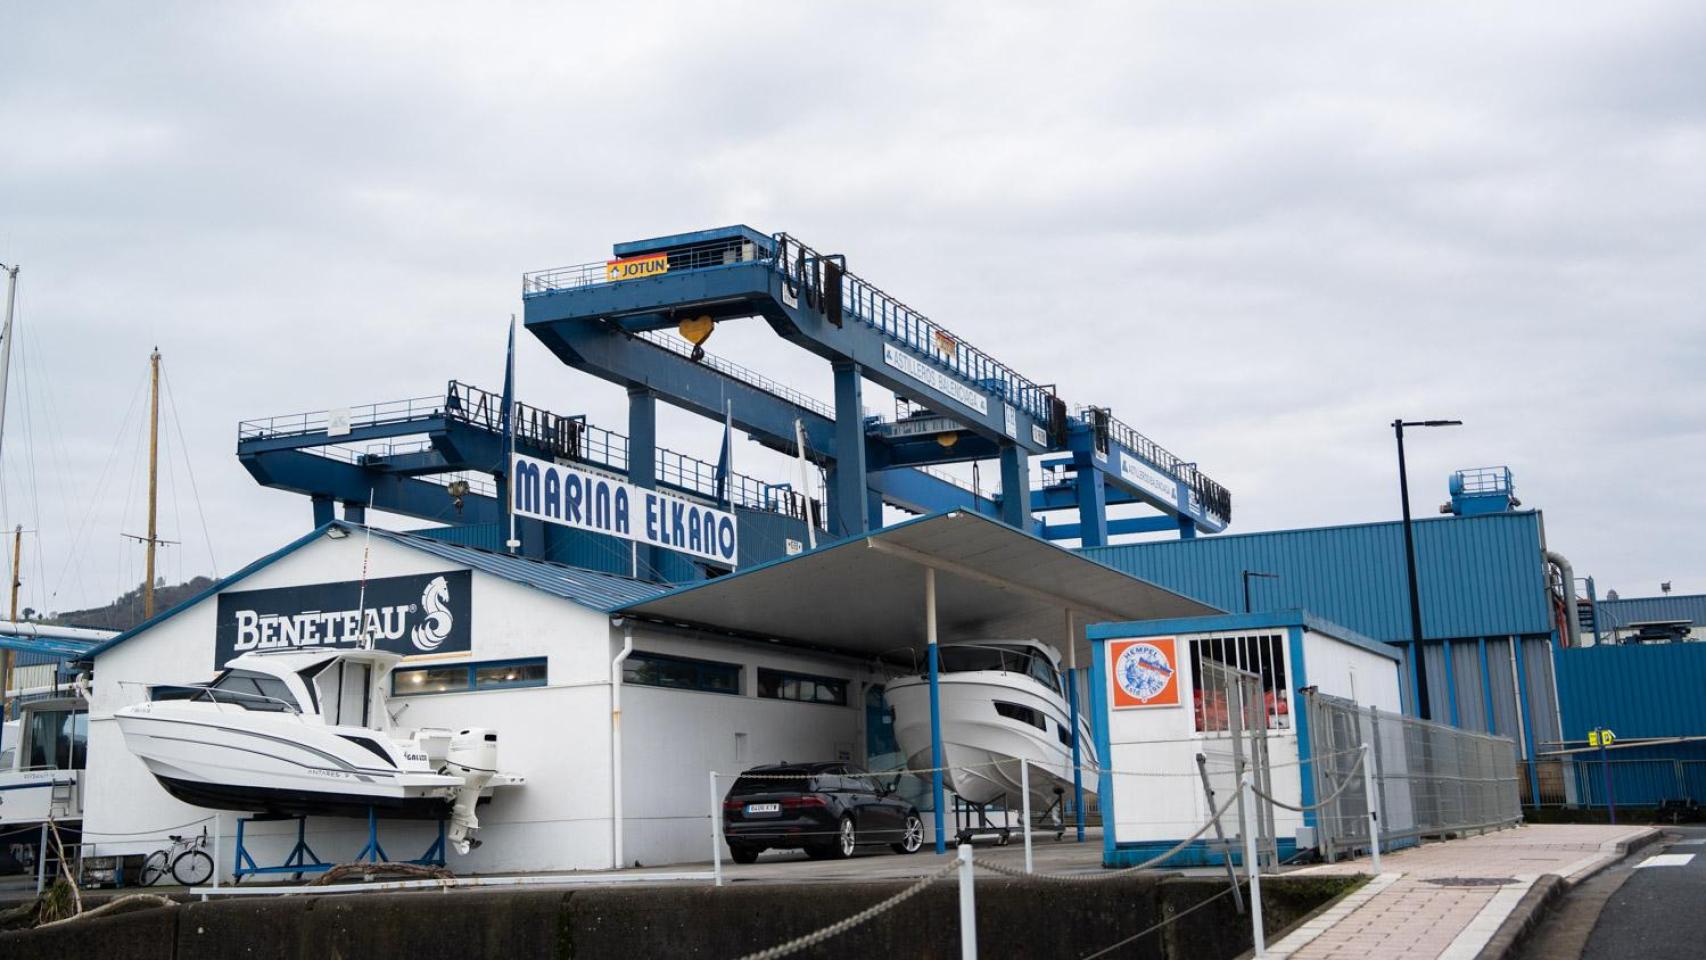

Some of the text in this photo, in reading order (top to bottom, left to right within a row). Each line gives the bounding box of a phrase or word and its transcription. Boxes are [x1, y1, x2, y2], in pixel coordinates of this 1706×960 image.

[623, 260, 664, 277] JOTUN
[894, 351, 937, 386] ASTILLEROS
[515, 459, 735, 560] MARINA ELKANO
[1123, 647, 1158, 659] HEMPEL
